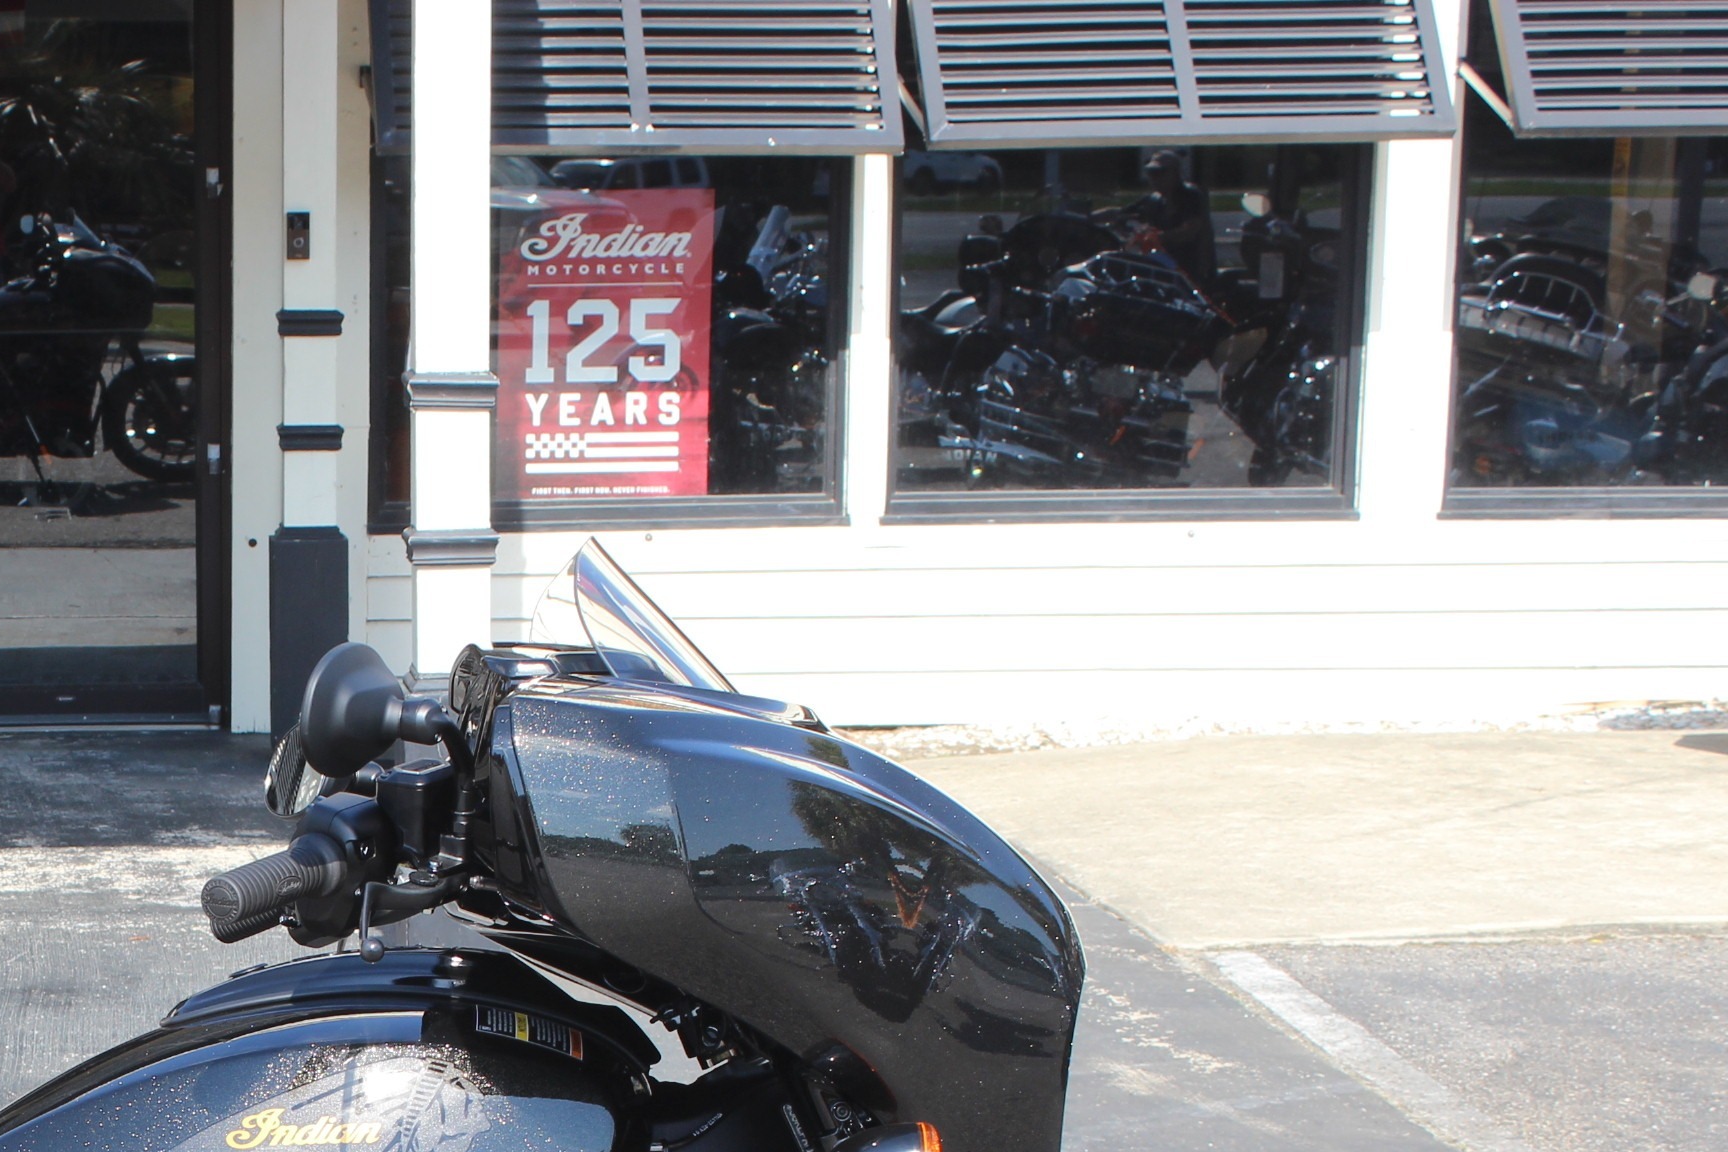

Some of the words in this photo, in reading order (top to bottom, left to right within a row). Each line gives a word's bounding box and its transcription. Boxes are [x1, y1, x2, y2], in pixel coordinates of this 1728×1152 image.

[521, 213, 692, 261] Indian
[527, 263, 684, 276] MOTORCYCLE
[524, 297, 682, 384] 125
[524, 391, 682, 427] YEARS
[225, 1107, 383, 1150] Indian
